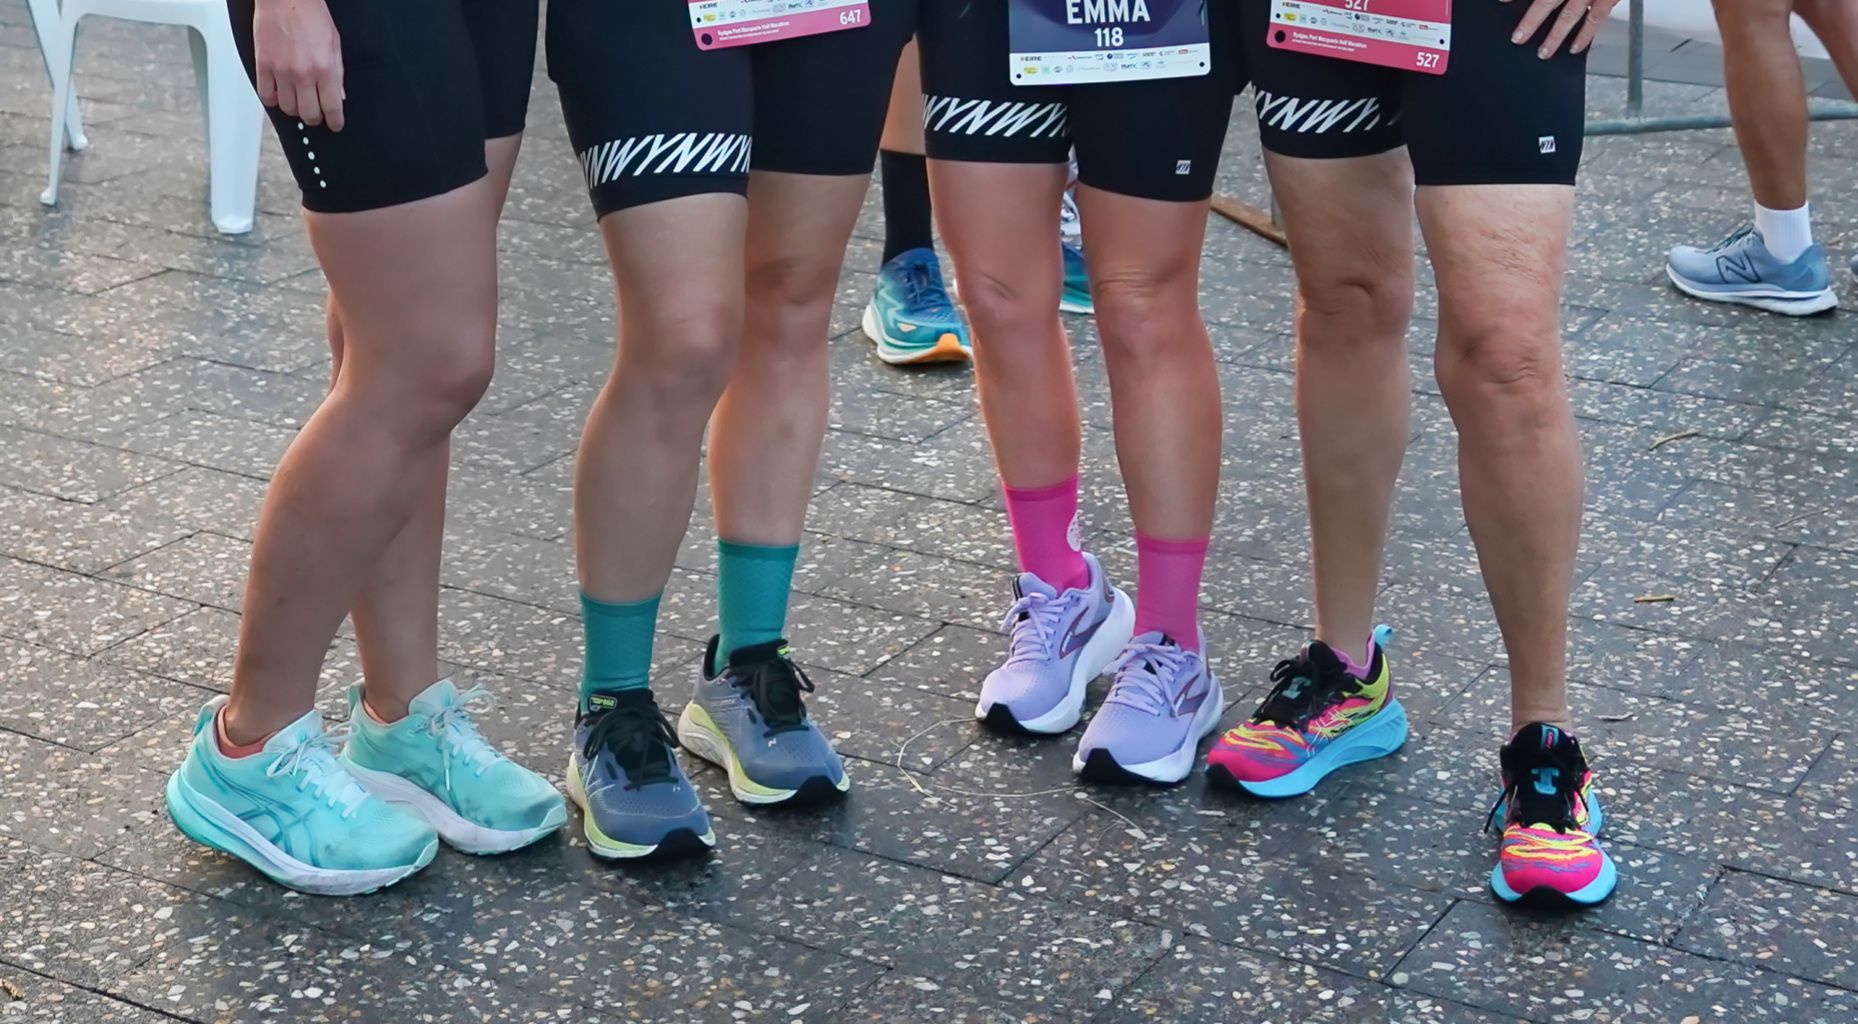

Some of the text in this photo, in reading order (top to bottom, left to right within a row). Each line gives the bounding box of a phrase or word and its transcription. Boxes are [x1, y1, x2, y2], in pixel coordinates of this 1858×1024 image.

[839, 10, 862, 25] 647
[1094, 27, 1124, 47] 118
[1416, 52, 1440, 68] 527
